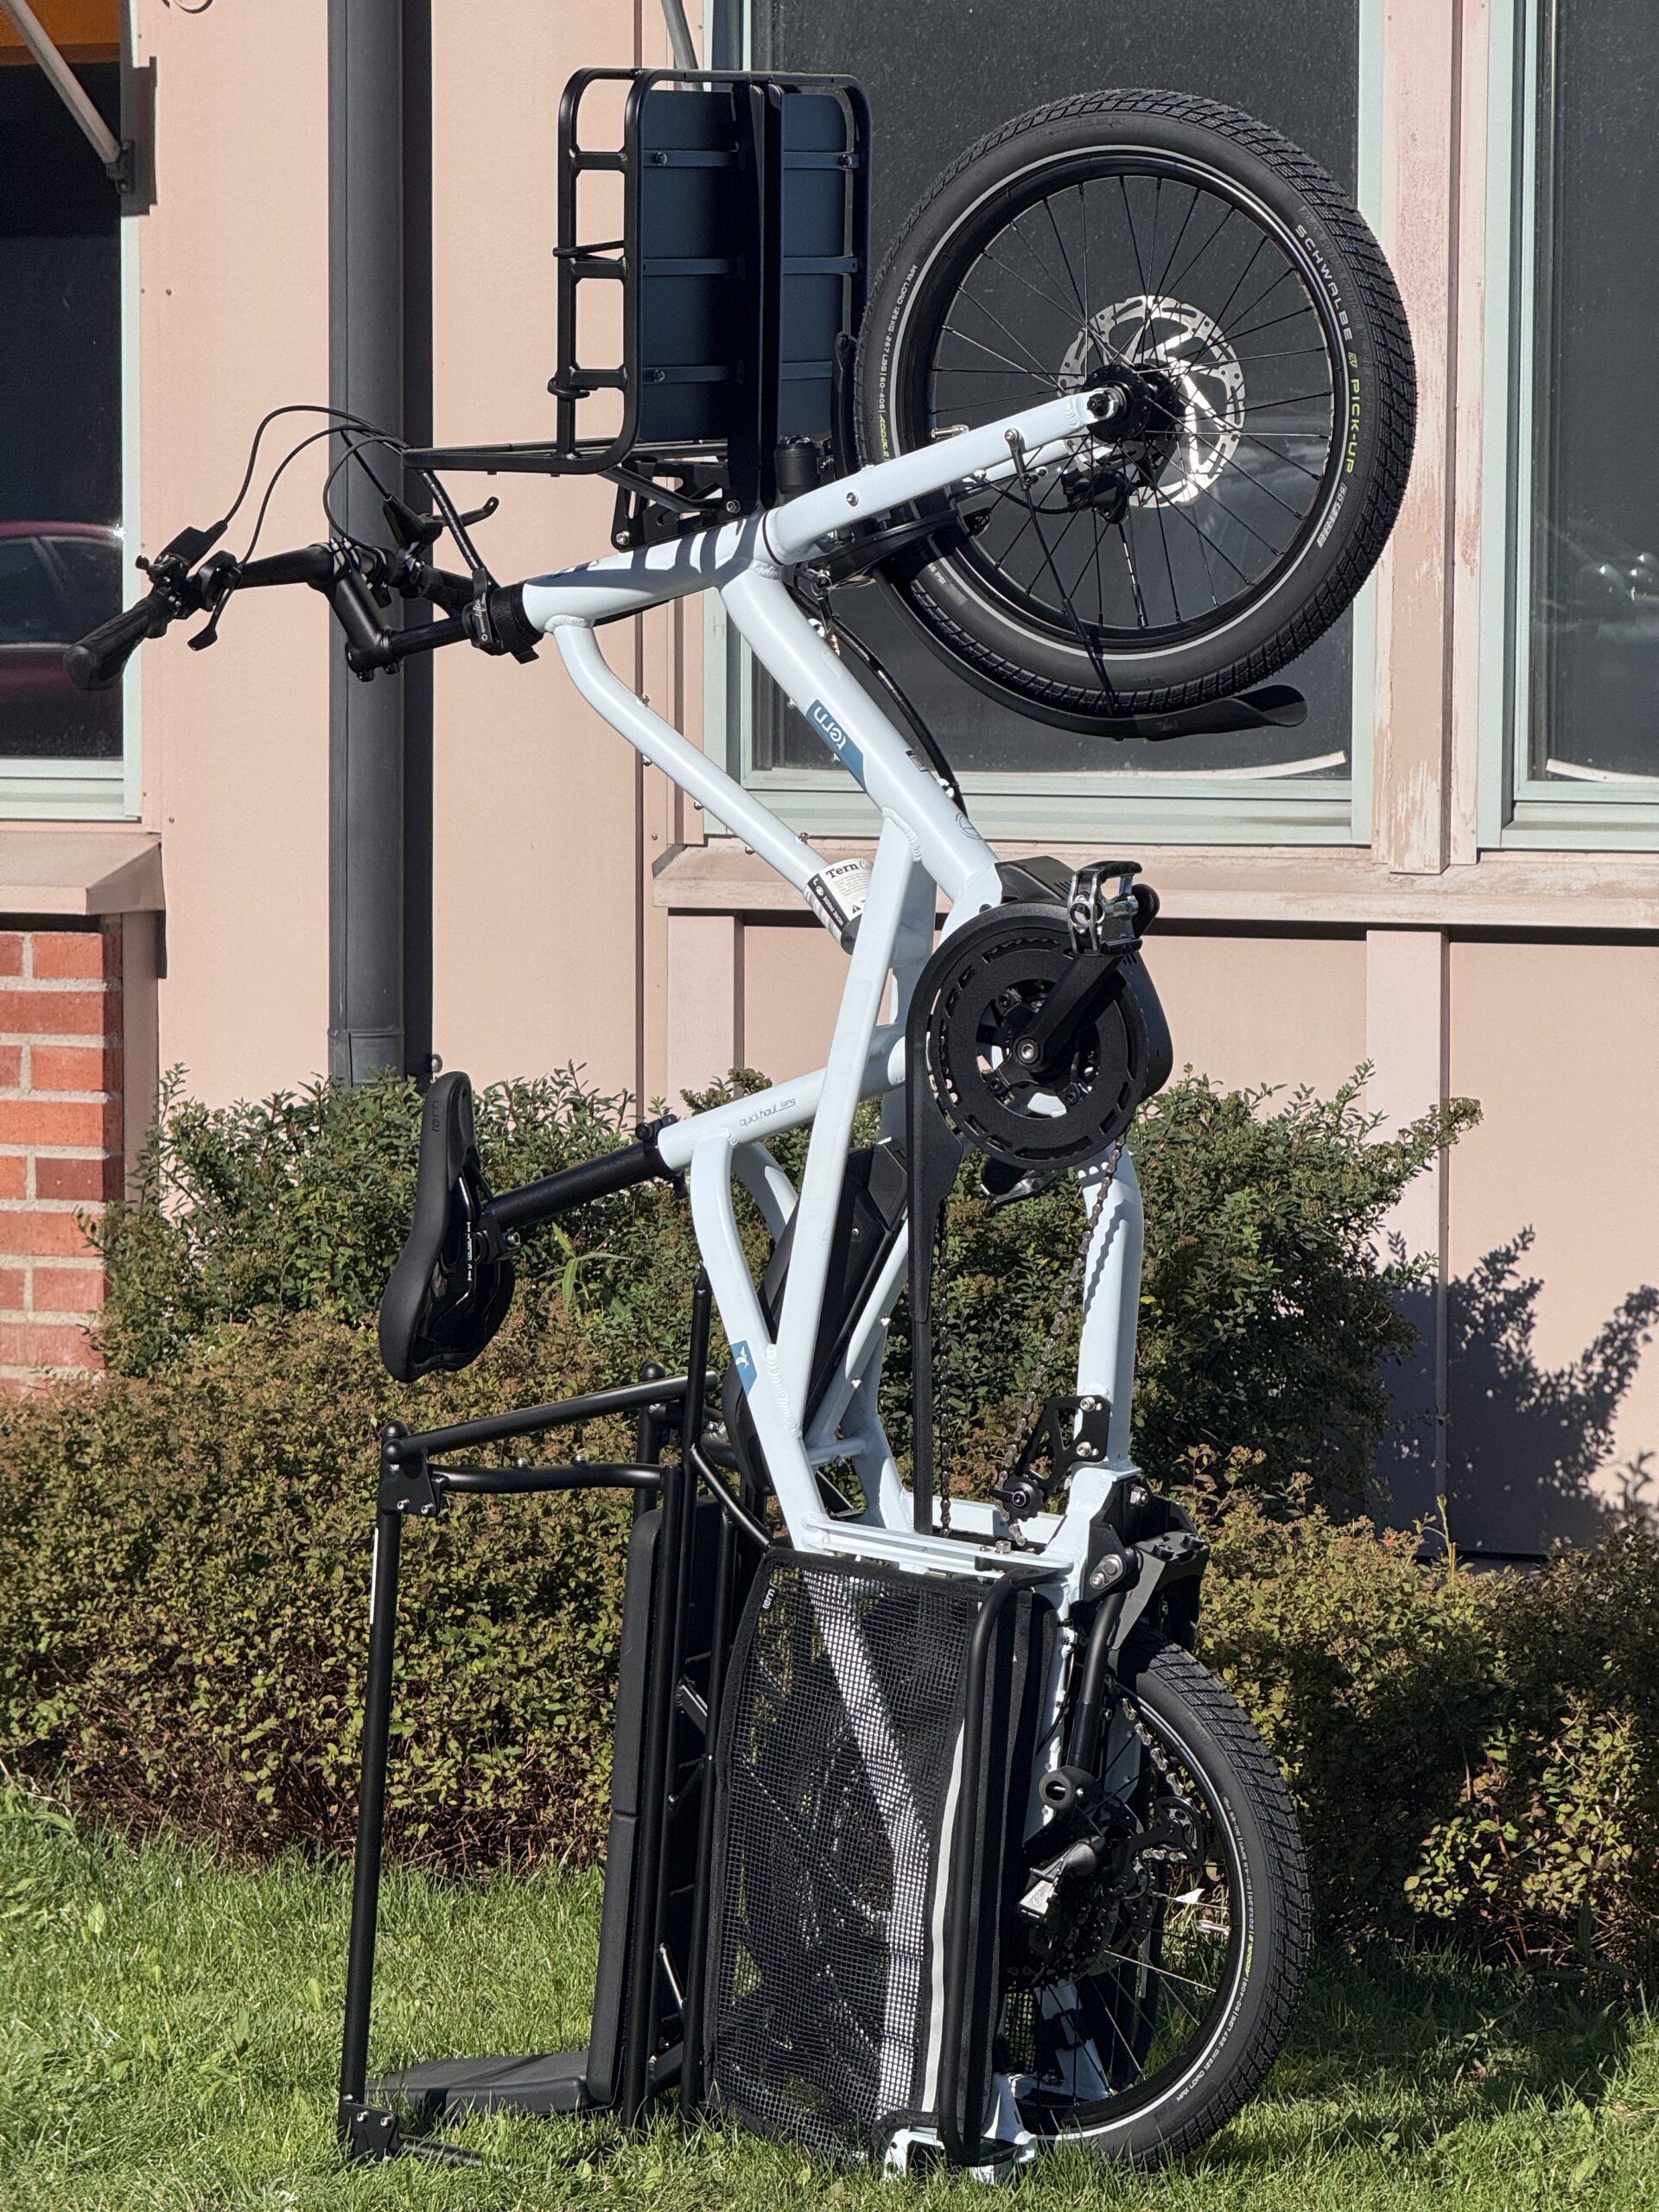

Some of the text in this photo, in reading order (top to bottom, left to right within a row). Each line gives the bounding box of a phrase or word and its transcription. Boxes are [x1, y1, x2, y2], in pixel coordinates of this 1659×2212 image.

[906, 264, 918, 283] MAX
[1295, 224, 1354, 341] SCHWALBE
[897, 282, 910, 305] LOAD
[1346, 378, 1360, 474] PICK-UP
[813, 706, 847, 751] tern
[825, 863, 860, 879] Tern
[762, 1588, 776, 1609] tern
[1175, 2087, 1190, 2102] MAX
[1189, 2069, 1205, 2090] LOAD
